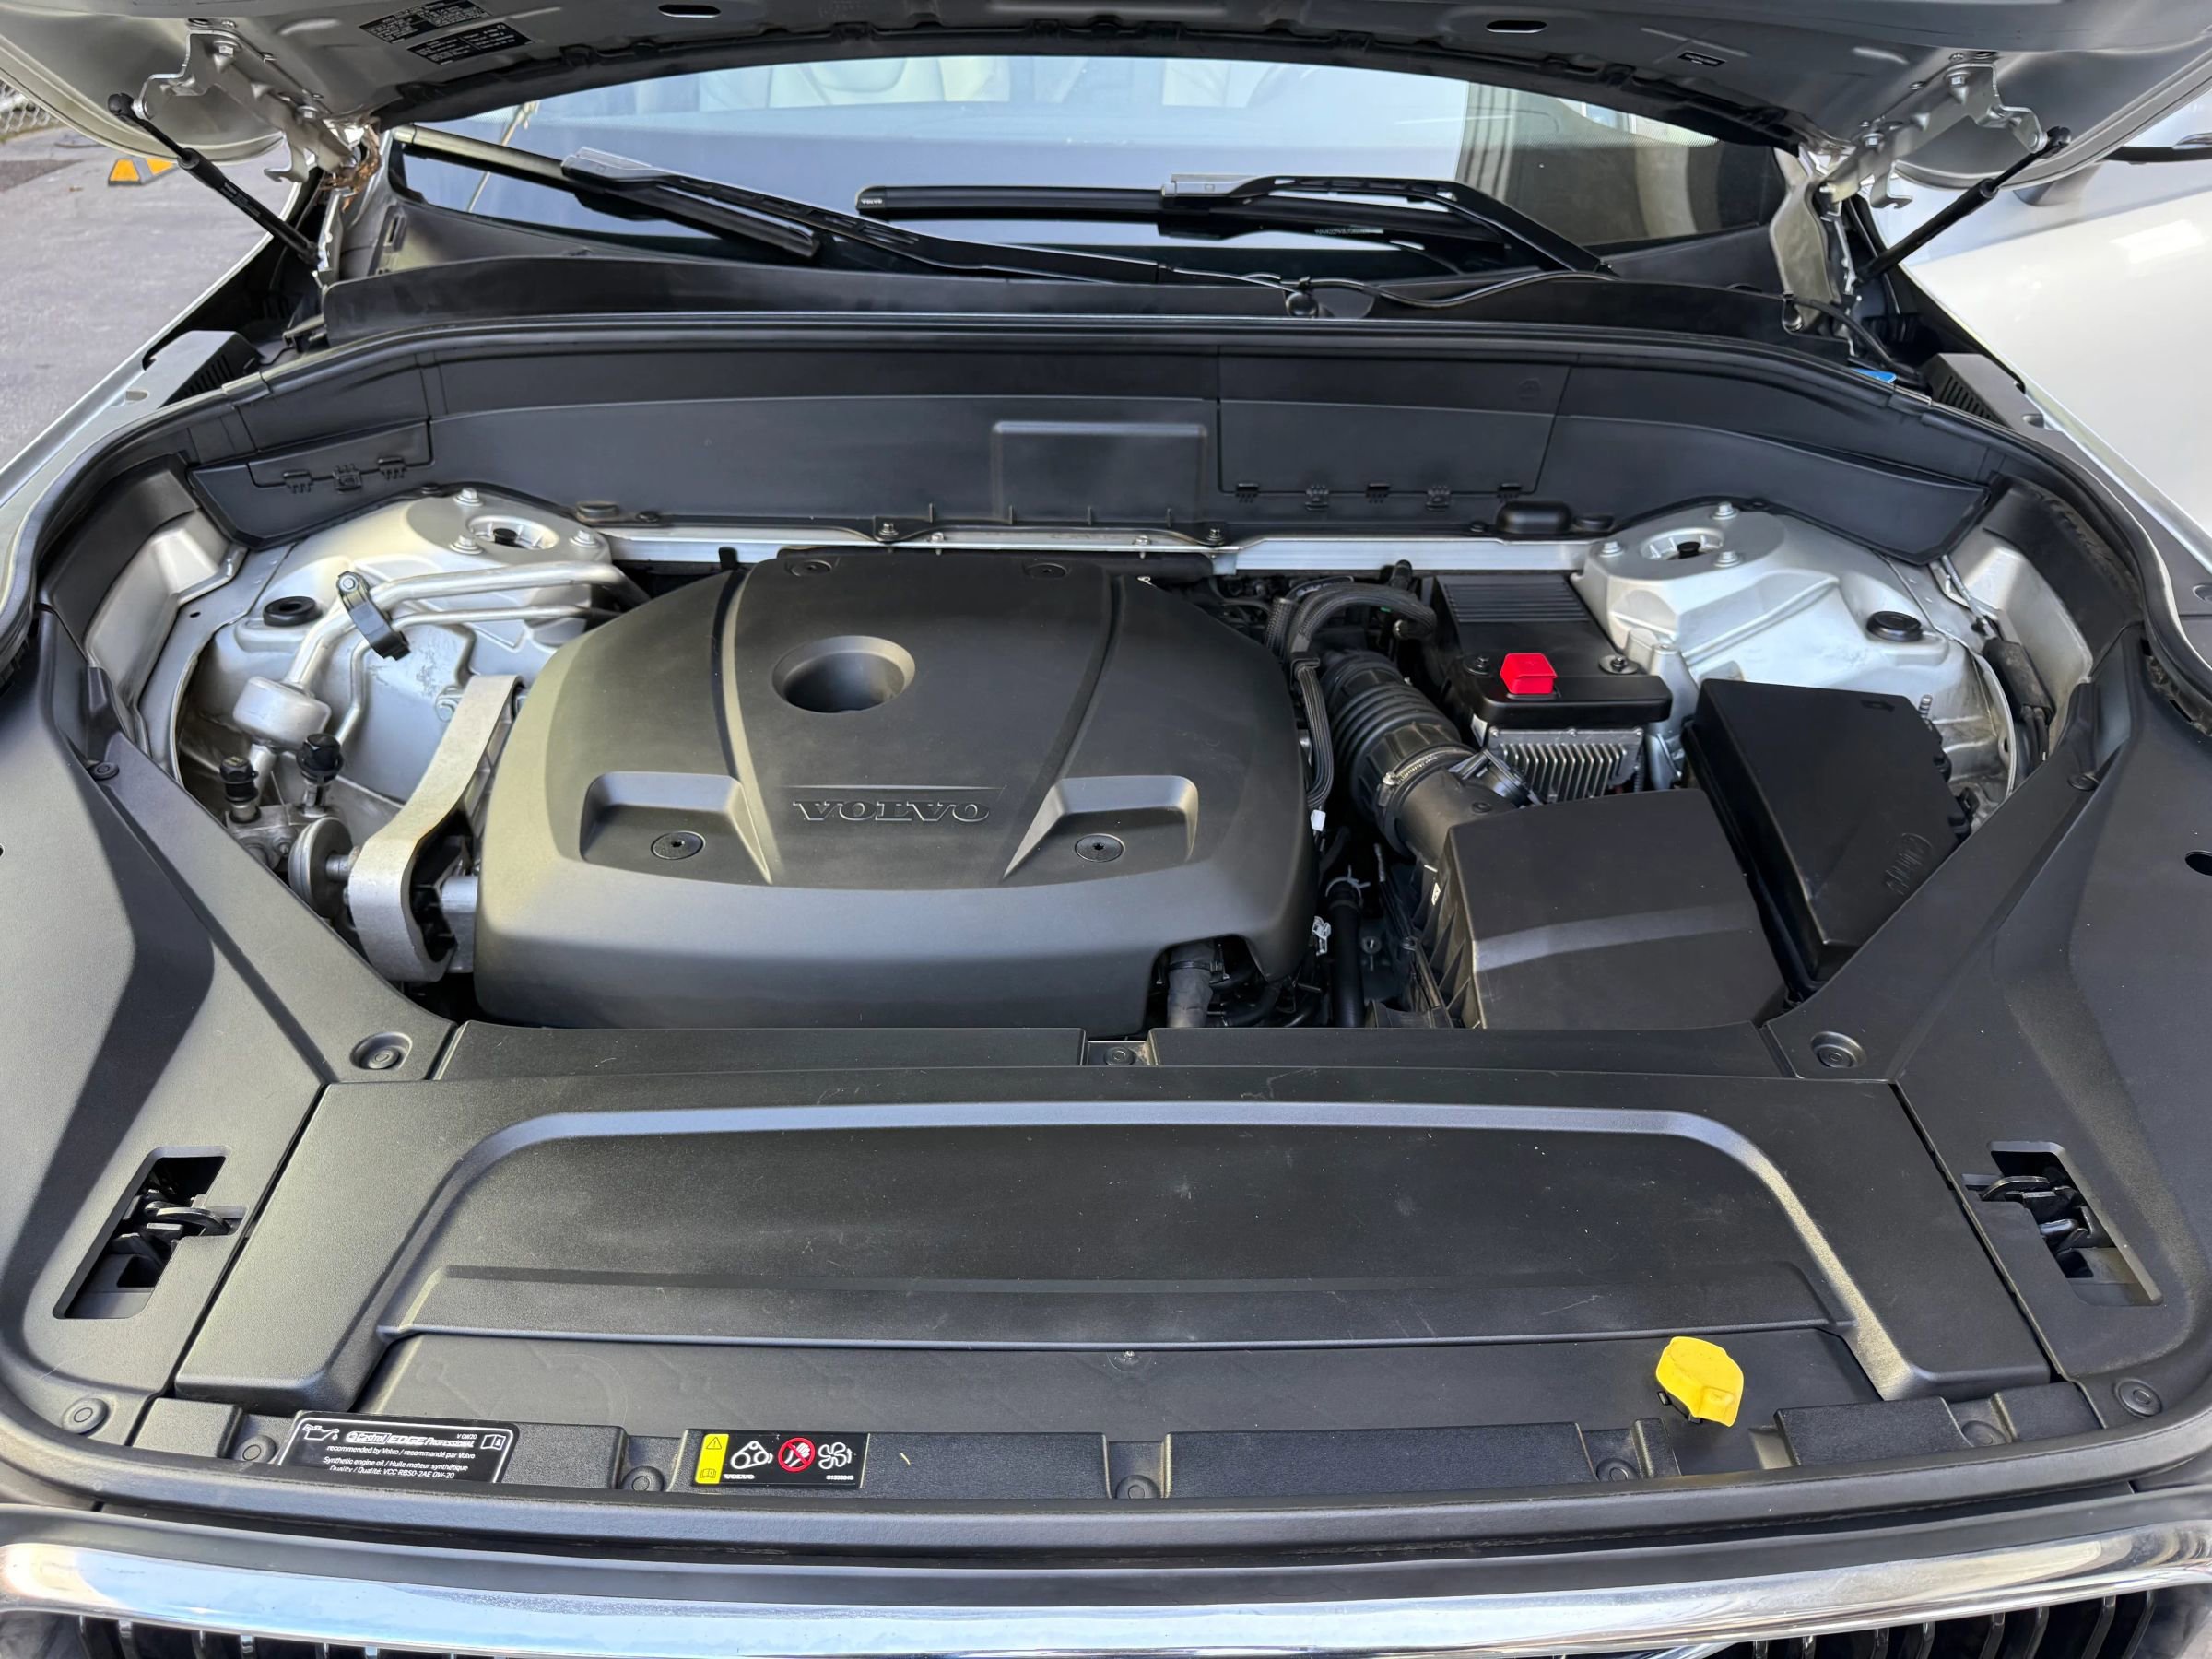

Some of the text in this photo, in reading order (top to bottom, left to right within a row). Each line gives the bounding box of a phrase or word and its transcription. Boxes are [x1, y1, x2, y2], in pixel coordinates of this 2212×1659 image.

[793, 800, 990, 823] VOLVO
[357, 1433, 387, 1442] Castrol
[388, 1435, 427, 1444] EDGE
[323, 1456, 353, 1465] Synthetic
[389, 1460, 406, 1468] Huile
[431, 1463, 468, 1471] synthétique
